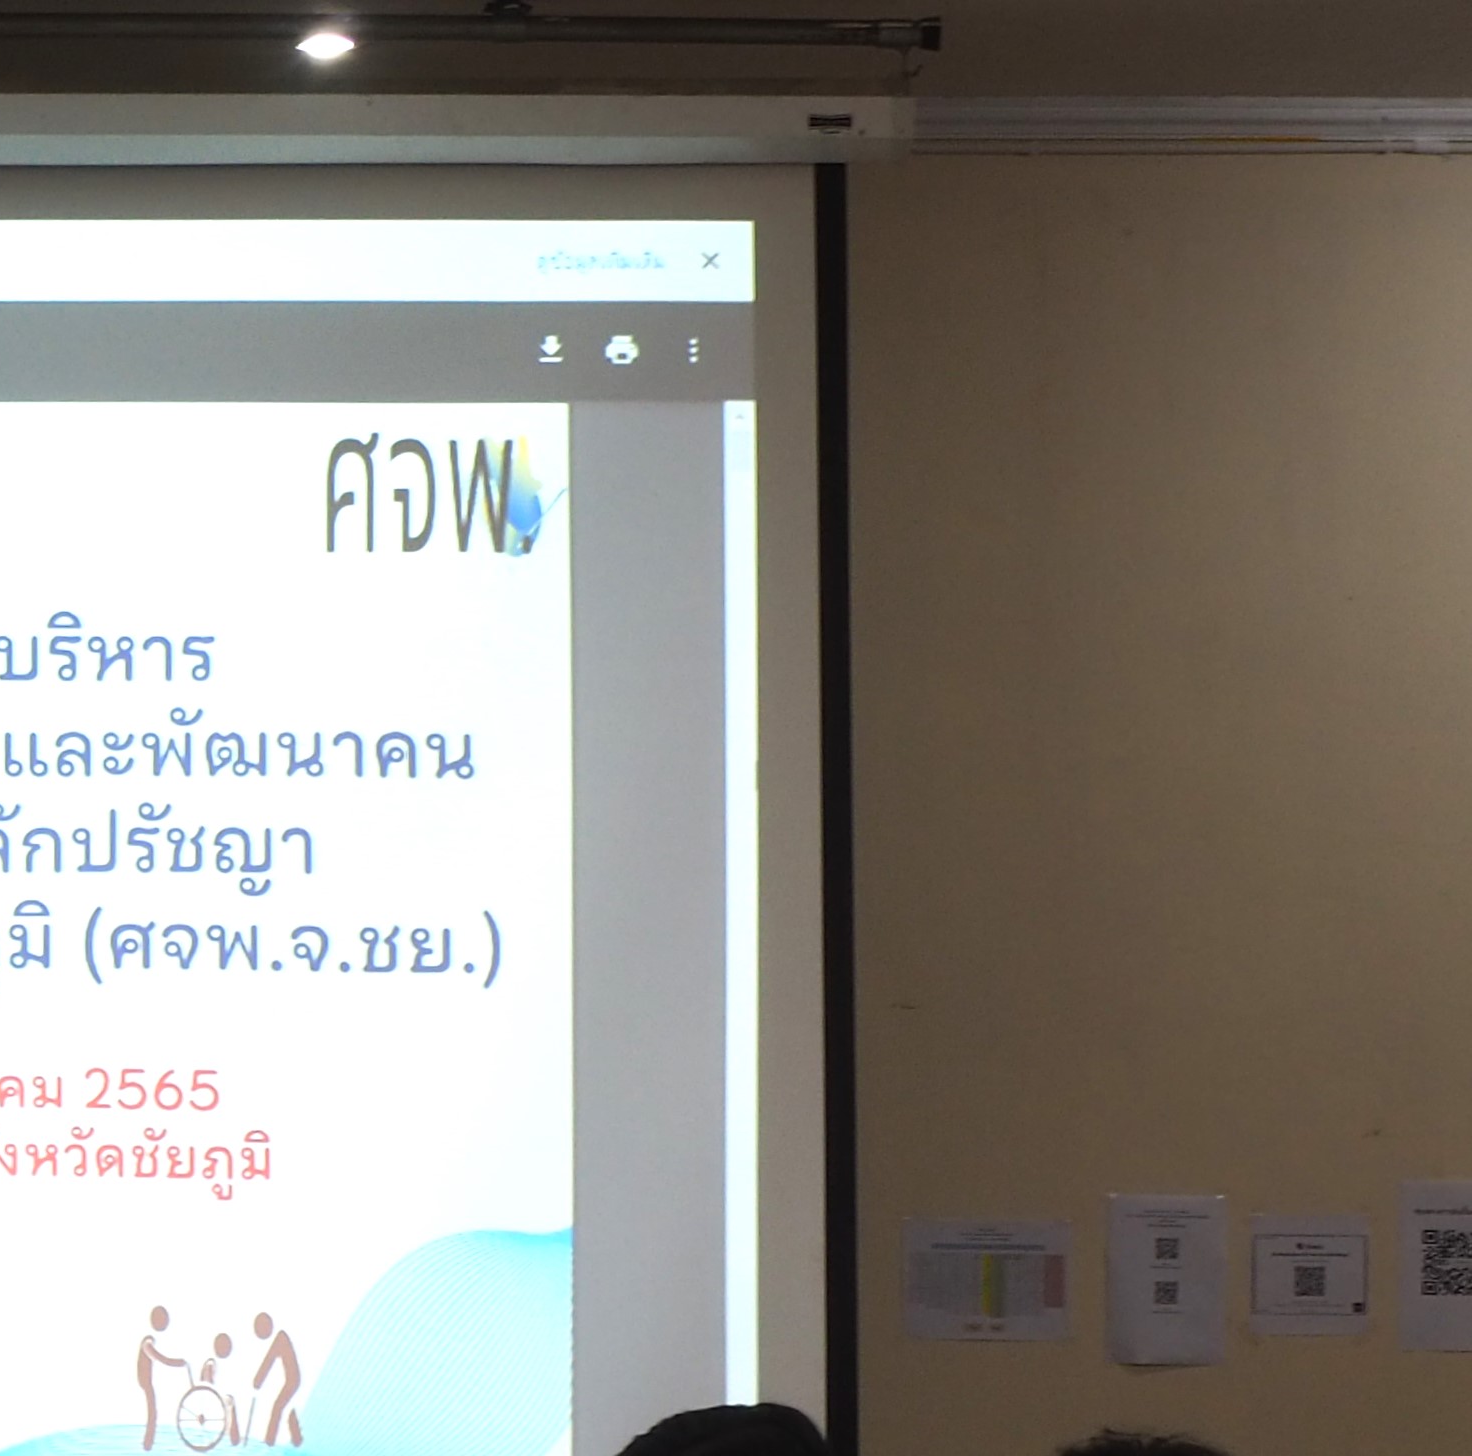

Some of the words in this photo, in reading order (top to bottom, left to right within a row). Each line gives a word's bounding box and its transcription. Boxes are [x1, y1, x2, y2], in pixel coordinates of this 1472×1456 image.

[85, 907, 501, 987] (ศจพ.จ.ชย.)
[85, 1067, 220, 1112] 2565
